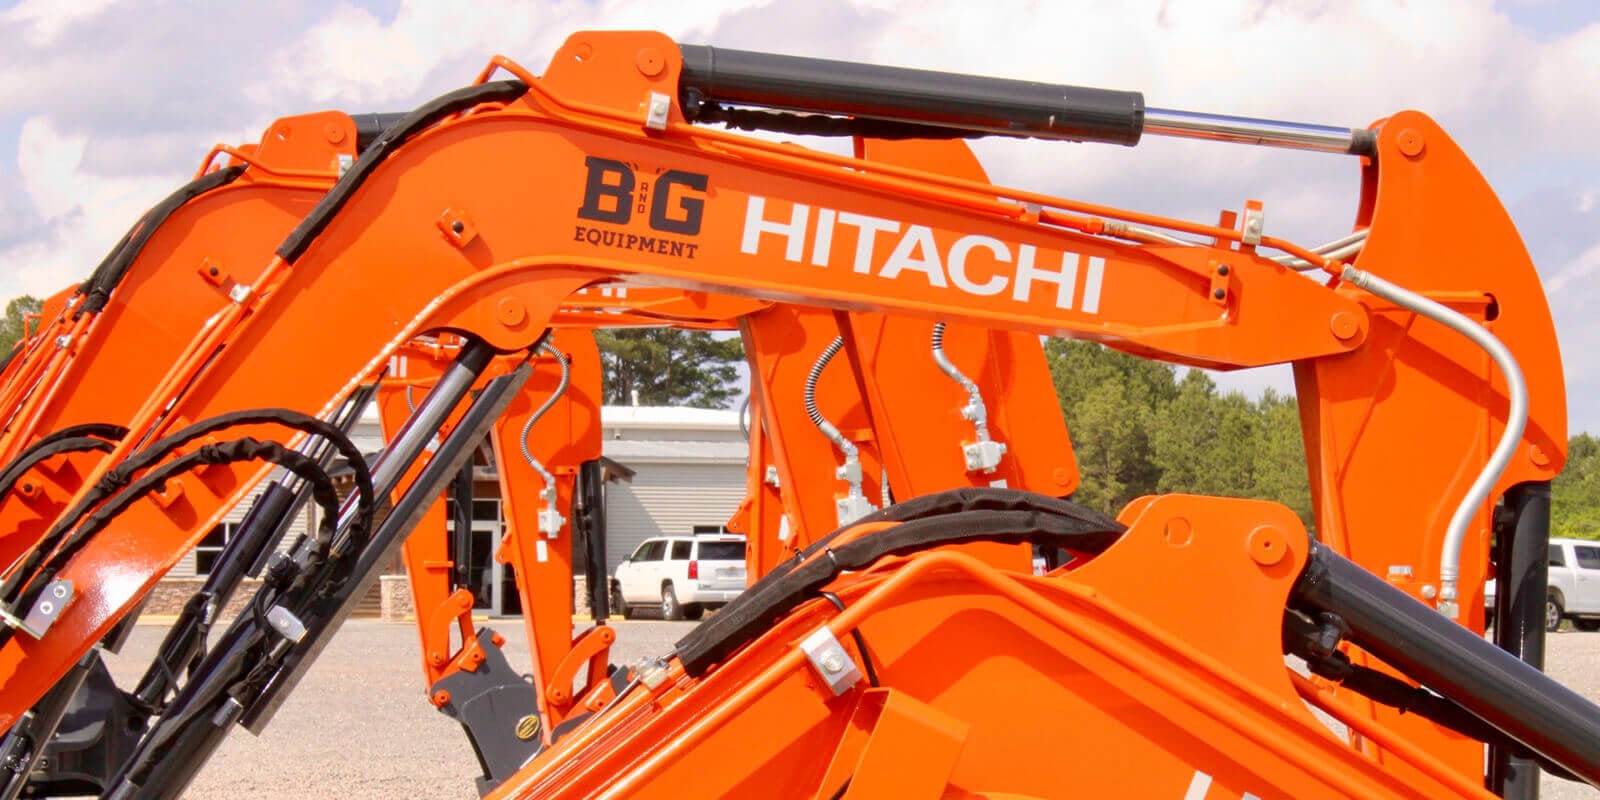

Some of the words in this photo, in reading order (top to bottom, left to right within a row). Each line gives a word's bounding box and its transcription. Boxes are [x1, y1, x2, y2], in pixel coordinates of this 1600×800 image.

[577, 155, 636, 225] B
[649, 169, 709, 236] G
[574, 226, 698, 259] EQUIPMENT
[740, 195, 1105, 314] HITACHI
